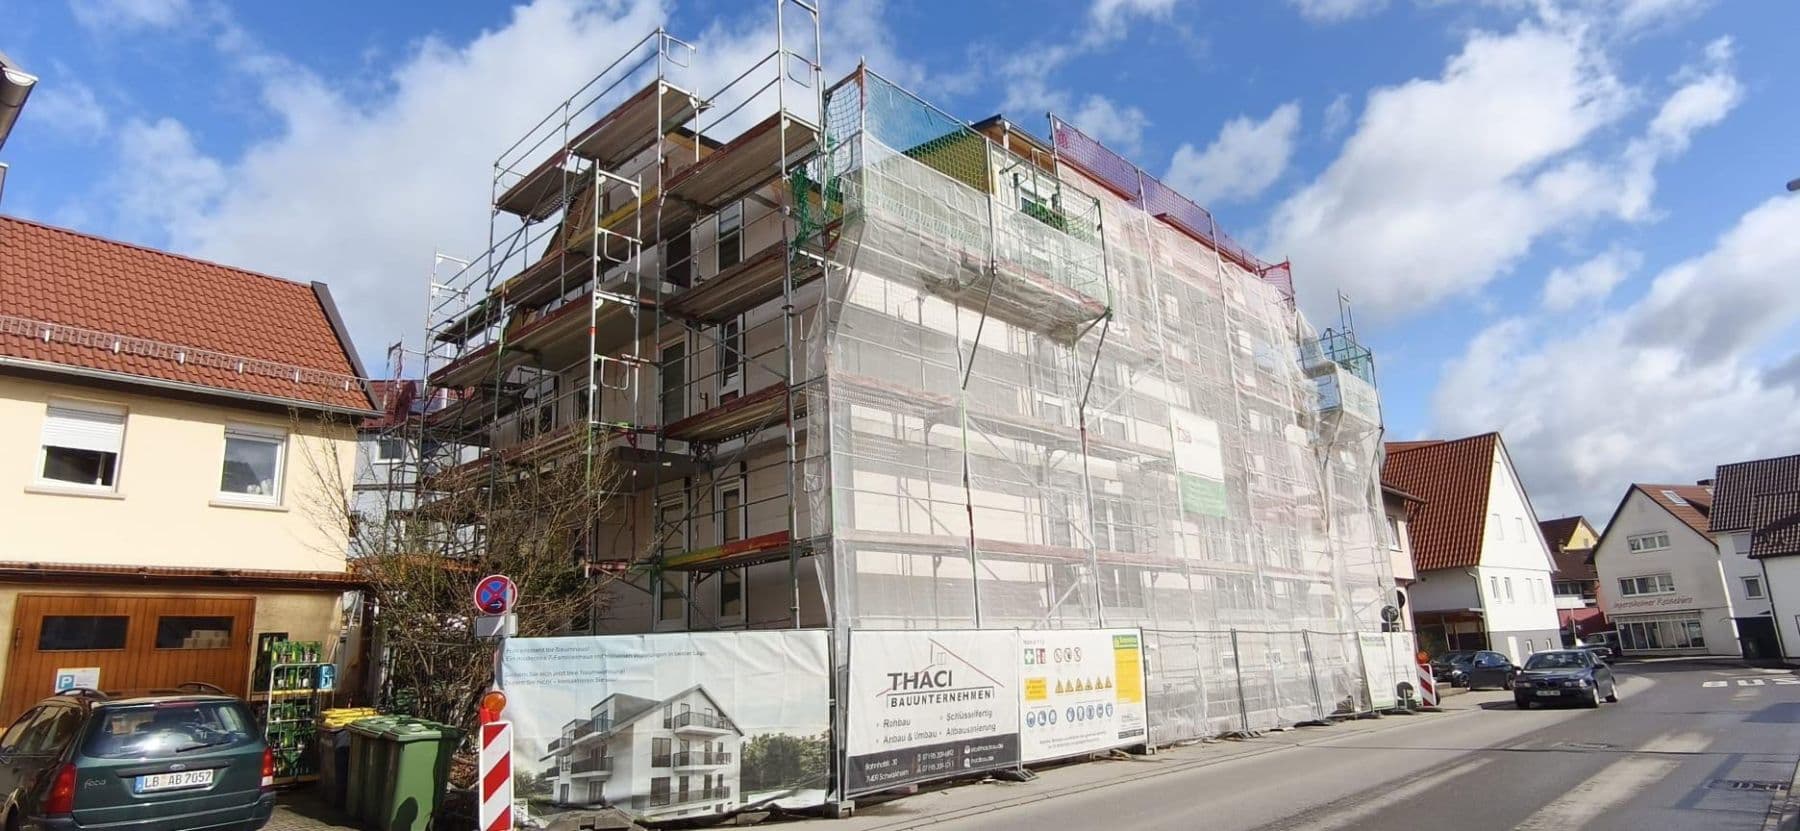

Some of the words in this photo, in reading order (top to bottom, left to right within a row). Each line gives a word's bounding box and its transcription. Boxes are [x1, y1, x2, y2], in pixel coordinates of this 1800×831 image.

[61, 676, 73, 688] P
[887, 669, 954, 691] THACI
[890, 689, 992, 708] BAUUNTERNEHMEN
[144, 776, 160, 789] LB
[167, 774, 183, 786] AB
